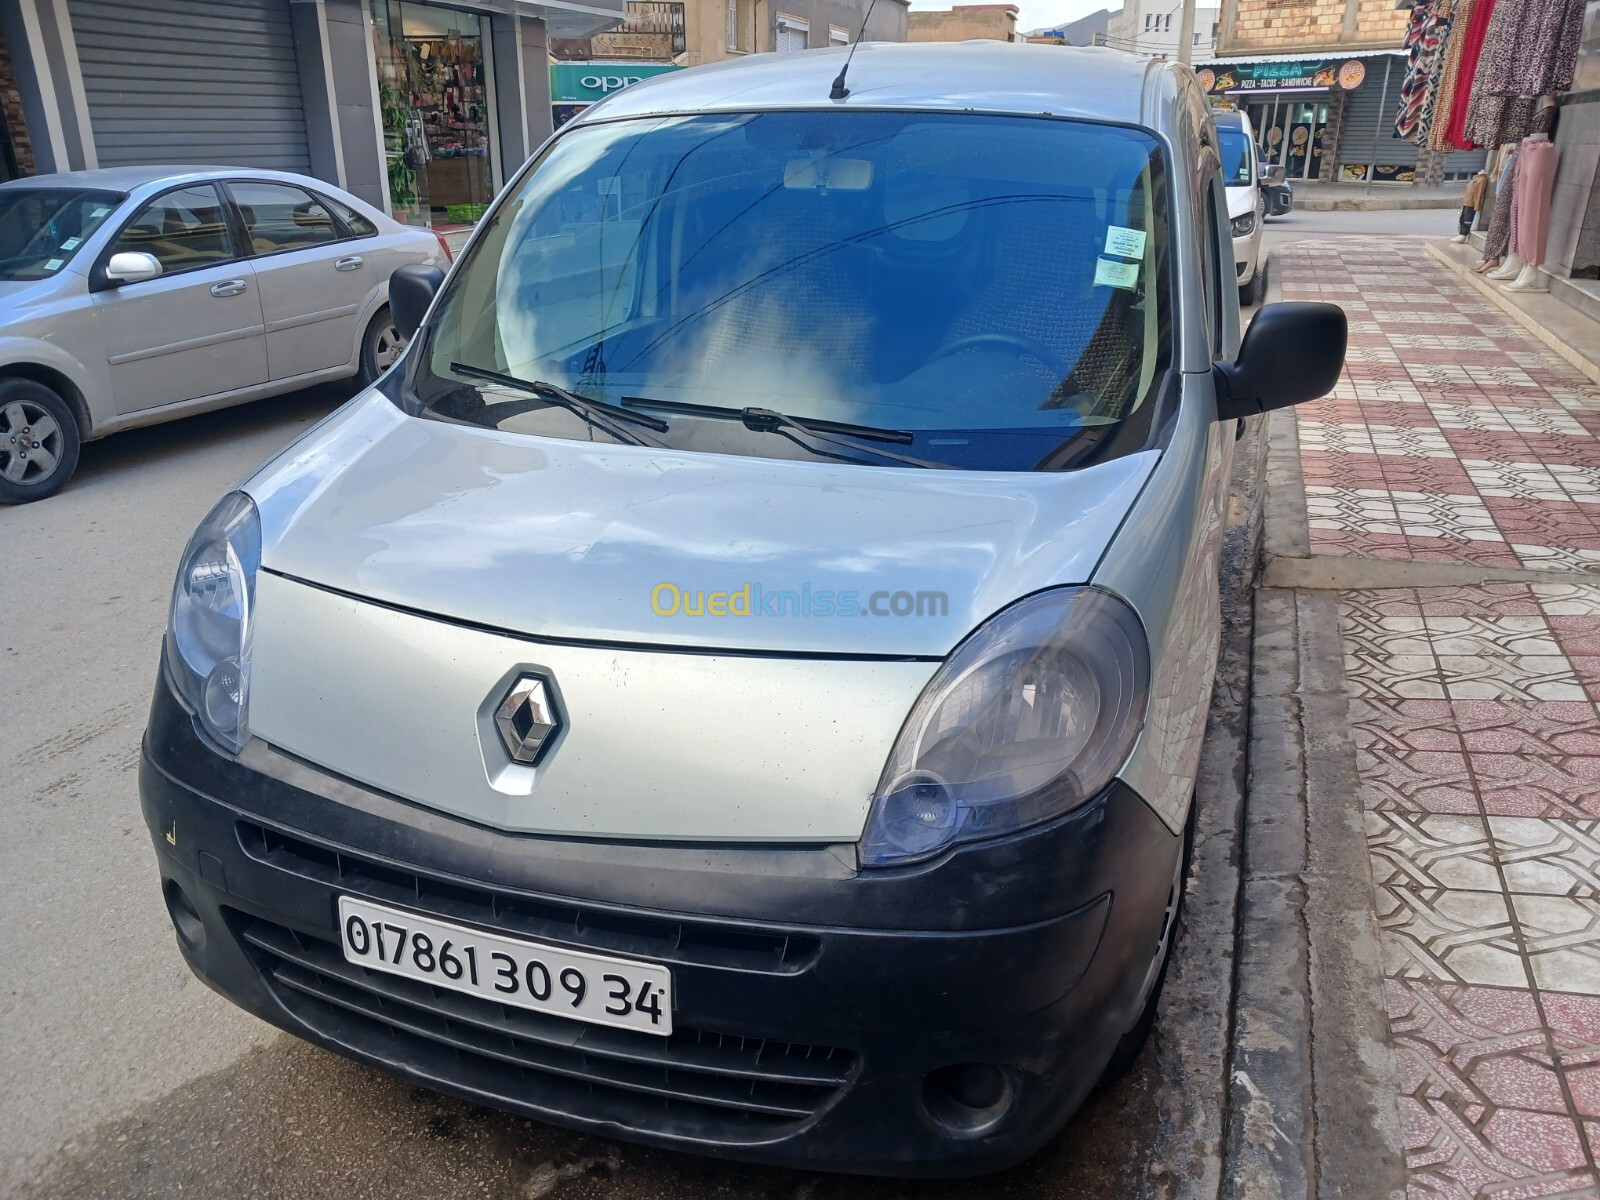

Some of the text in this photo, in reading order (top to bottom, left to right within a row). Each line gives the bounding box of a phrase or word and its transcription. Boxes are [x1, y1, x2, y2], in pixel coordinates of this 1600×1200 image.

[1253, 62, 1302, 77] PIZZA
[581, 76, 643, 92] opp
[1241, 79, 1256, 88] PIZZA
[346, 914, 662, 1024] 017861 309 34
